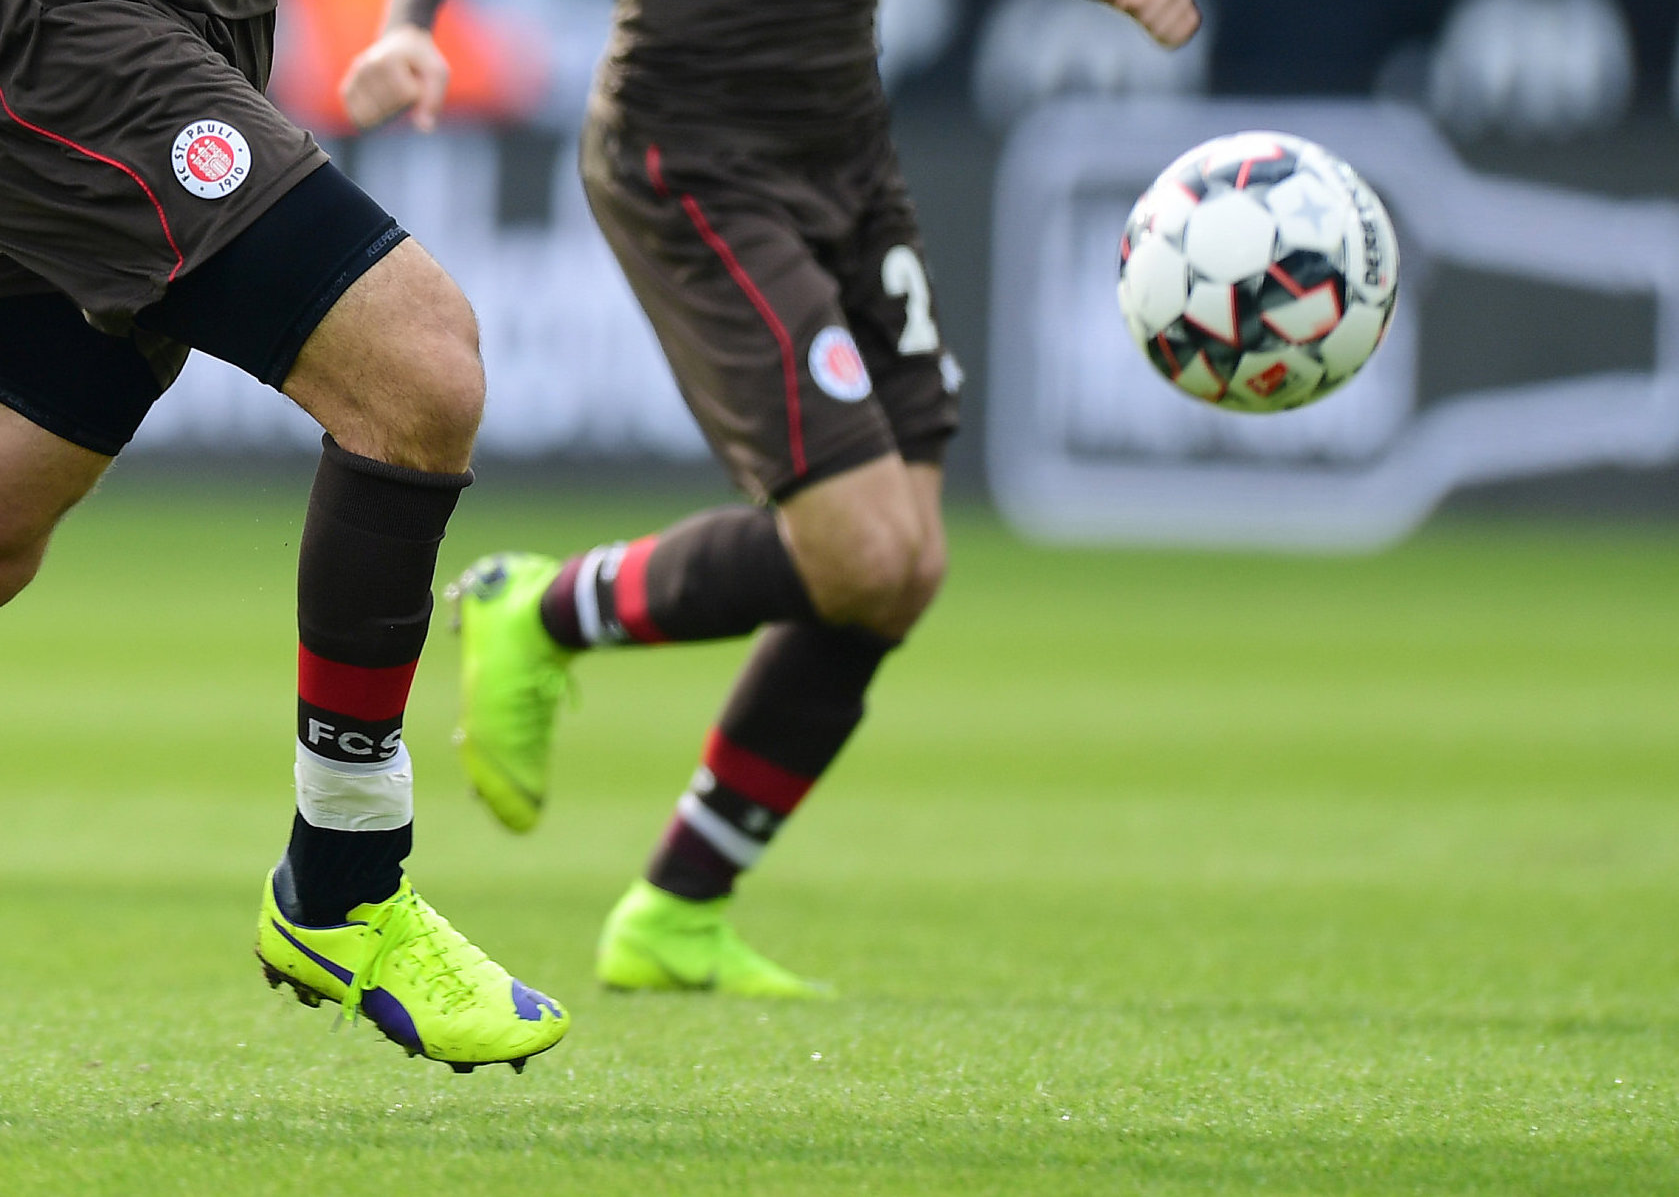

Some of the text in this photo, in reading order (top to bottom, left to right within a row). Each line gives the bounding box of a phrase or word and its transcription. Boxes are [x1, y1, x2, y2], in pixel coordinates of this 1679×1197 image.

[177, 167, 190, 182] FC
[186, 123, 233, 139] PAULI
[218, 167, 244, 192] 1910
